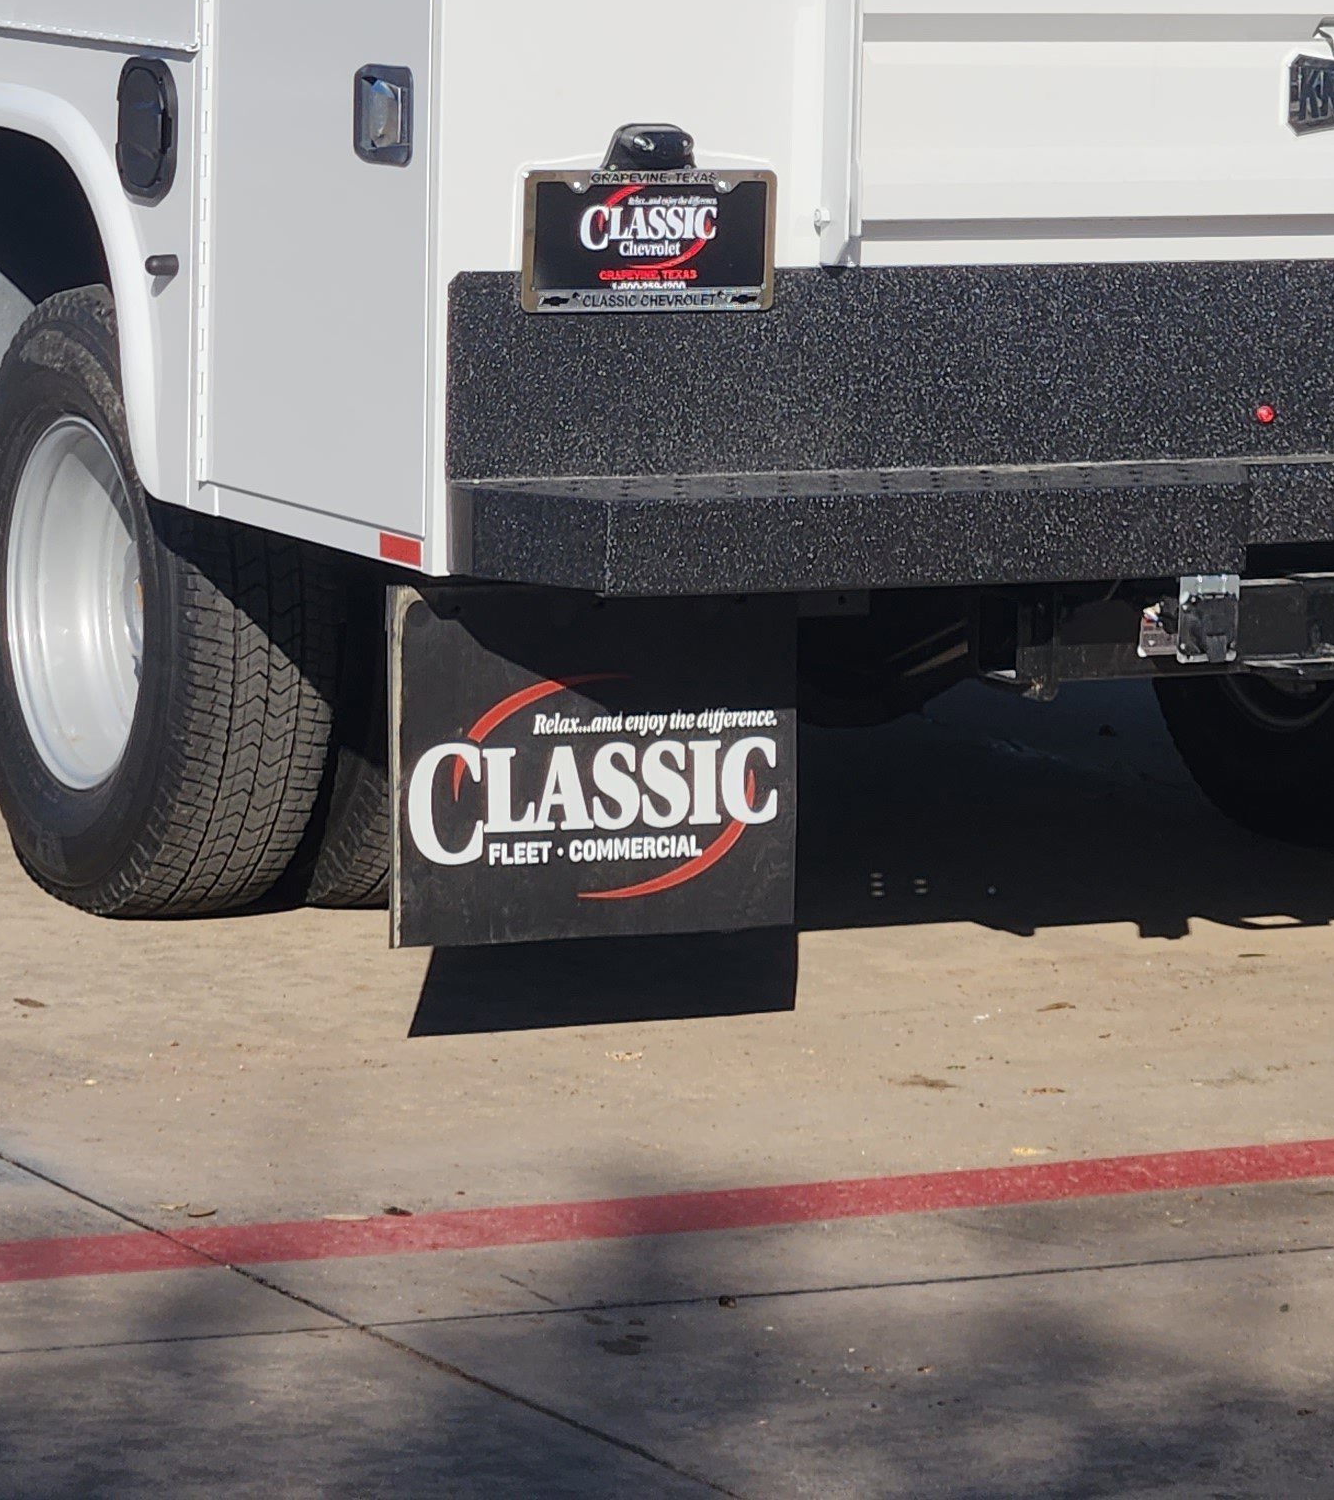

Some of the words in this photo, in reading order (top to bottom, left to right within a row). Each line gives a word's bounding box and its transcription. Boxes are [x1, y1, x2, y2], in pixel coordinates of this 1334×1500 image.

[675, 172, 717, 183] TEXAS
[579, 205, 718, 251] CLASSIC
[619, 241, 681, 256] Chevrolet
[662, 269, 698, 280] TEXAS
[582, 294, 637, 308] CLASSIC
[640, 293, 716, 307] CHEVROLET
[624, 711, 668, 737] enjoy
[669, 709, 695, 730] the
[696, 707, 778, 734] difference.
[407, 735, 778, 866] CLASSIC
[488, 840, 553, 866] FLEET
[568, 834, 703, 862] COMMERCIAL
